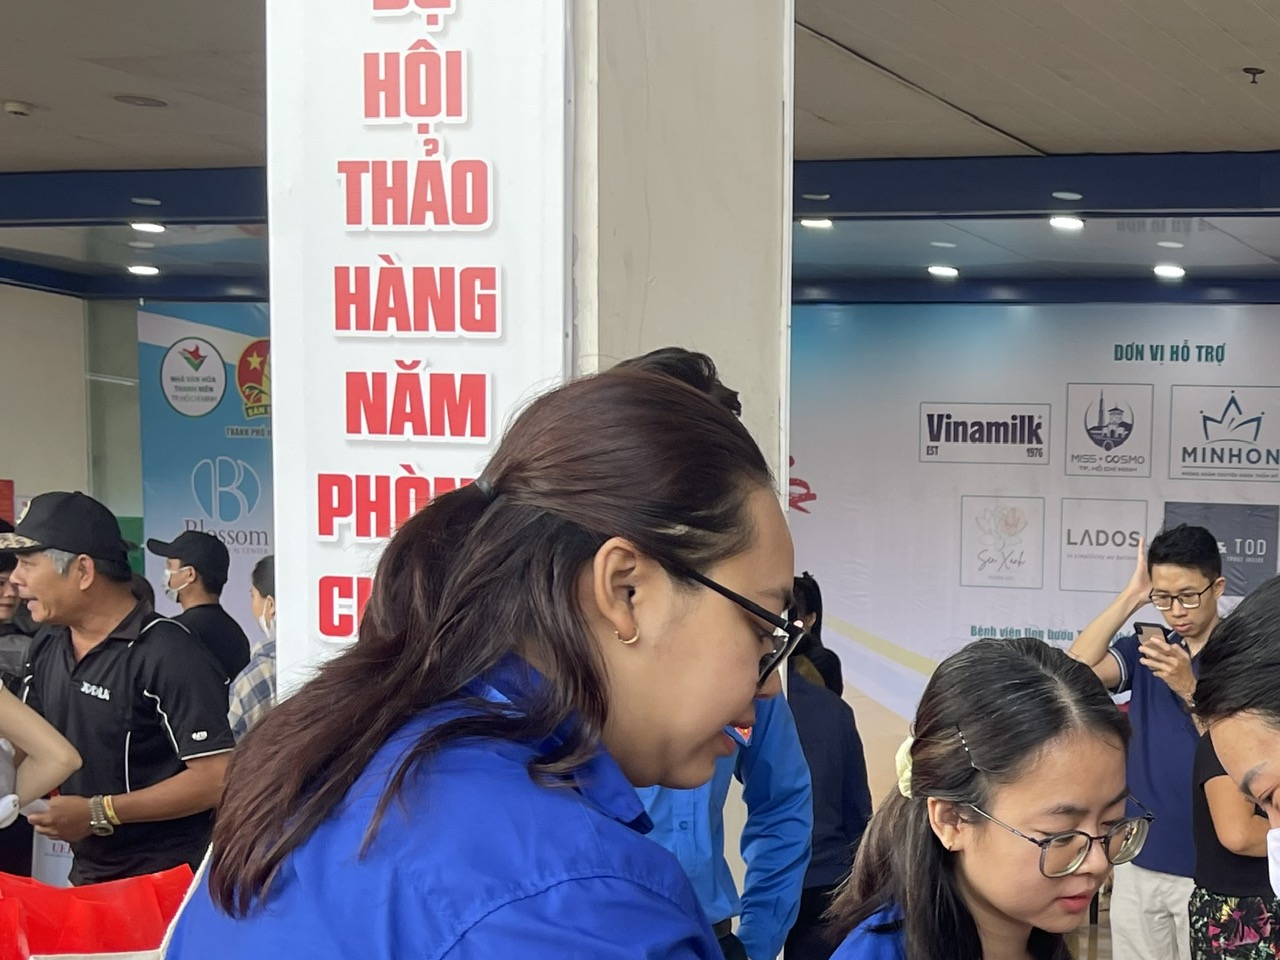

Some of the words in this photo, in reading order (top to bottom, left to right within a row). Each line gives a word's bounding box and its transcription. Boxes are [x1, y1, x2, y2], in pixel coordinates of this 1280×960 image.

[363, 38, 463, 135] HỘI
[337, 138, 488, 226] THẢO
[334, 254, 497, 333] HÀNG
[1114, 341, 1144, 362] ĐƠN
[1150, 344, 1165, 366] VỊ
[1169, 339, 1190, 363] HỖ
[1195, 342, 1226, 366] TRỢ
[345, 359, 487, 438] NĂM
[926, 413, 1043, 445] Vinamilk
[926, 446, 939, 456] EST
[1026, 447, 1043, 458] 1976
[1071, 454, 1097, 464] MISS
[1105, 454, 1145, 465] COSMO
[1181, 446, 1280, 465] MINHON
[1235, 538, 1267, 556] TOD
